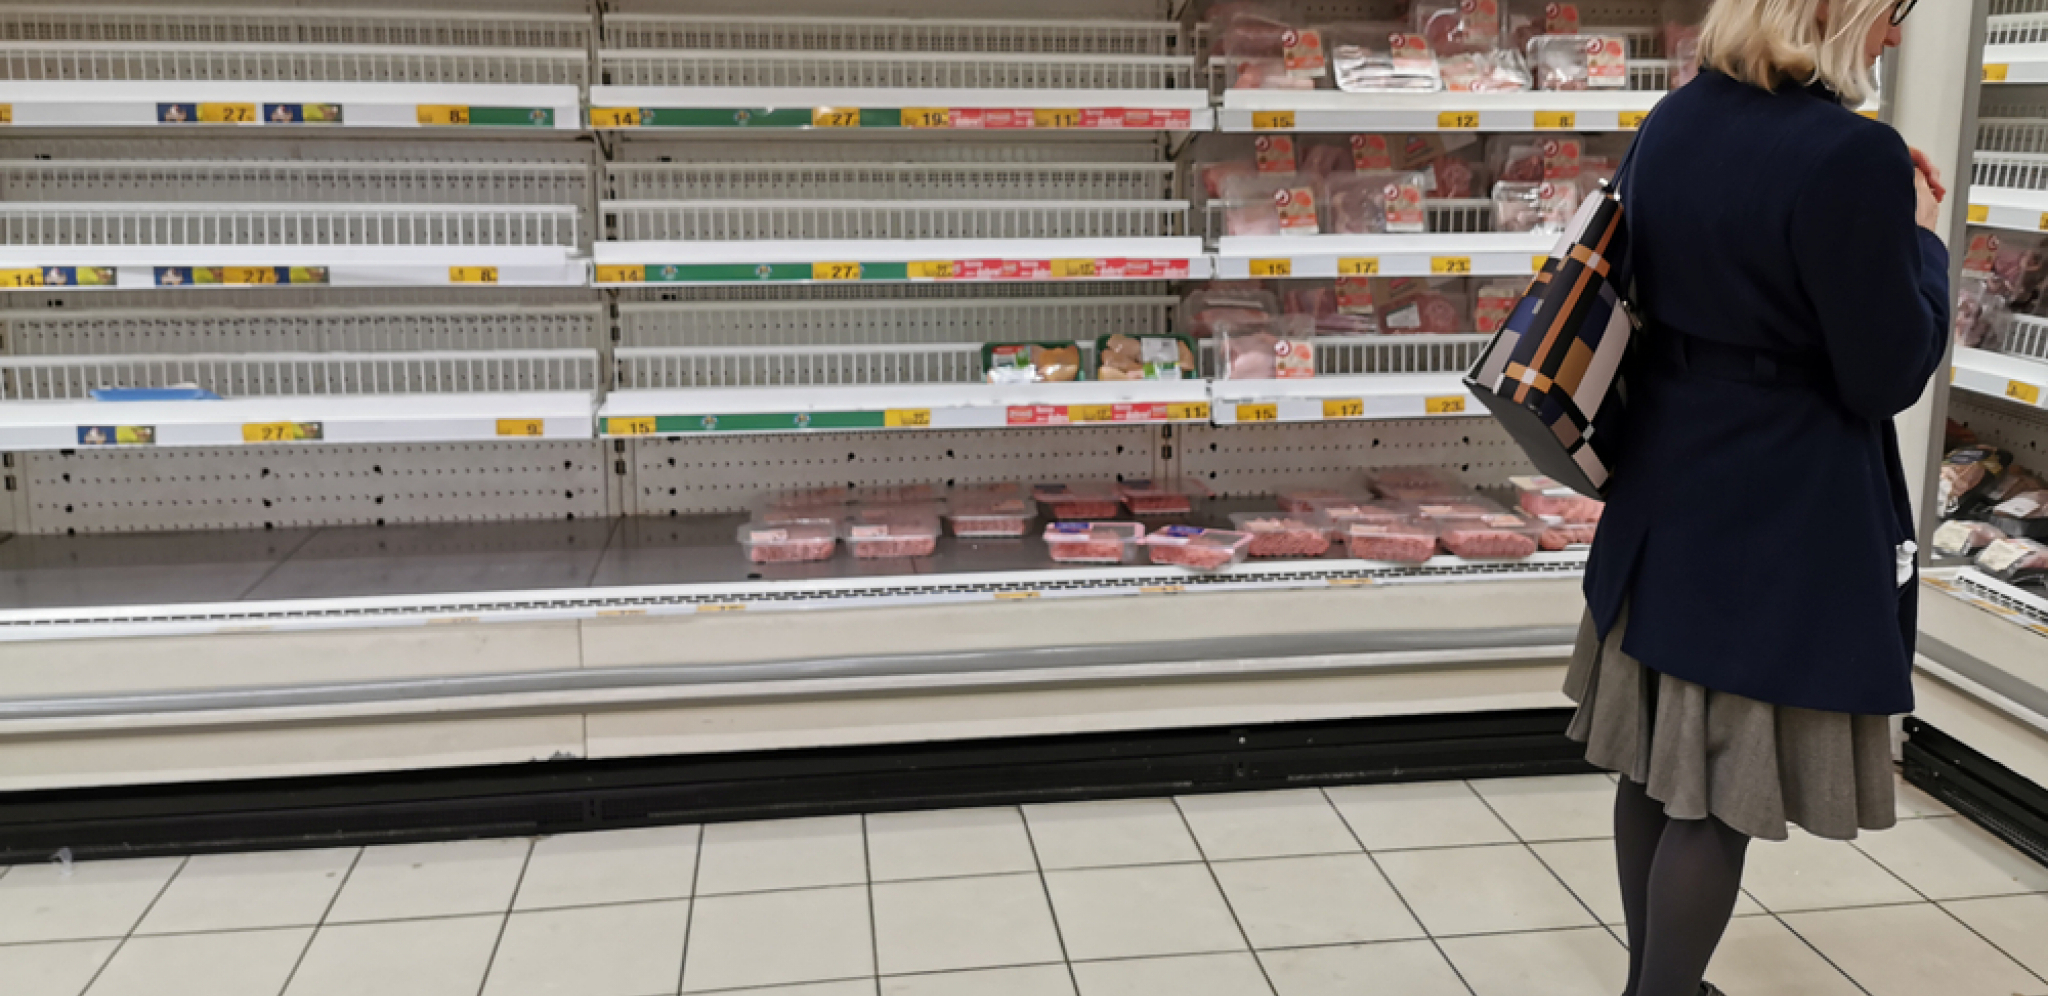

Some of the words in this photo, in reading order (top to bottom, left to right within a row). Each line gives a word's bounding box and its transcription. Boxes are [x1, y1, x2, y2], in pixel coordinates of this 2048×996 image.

[223, 107, 245, 121] 27
[612, 113, 632, 126] 14
[833, 113, 853, 126] 27
[924, 113, 942, 126] 19
[1054, 114, 1072, 127] 11
[1455, 115, 1473, 127] 12
[832, 266, 852, 279] 27
[1355, 262, 1372, 275] 17
[13, 273, 35, 287] 14
[243, 269, 265, 283] 27
[619, 270, 637, 281] 14
[1183, 406, 1200, 420] 11
[1341, 403, 1358, 416] 17
[260, 427, 285, 441] 27
